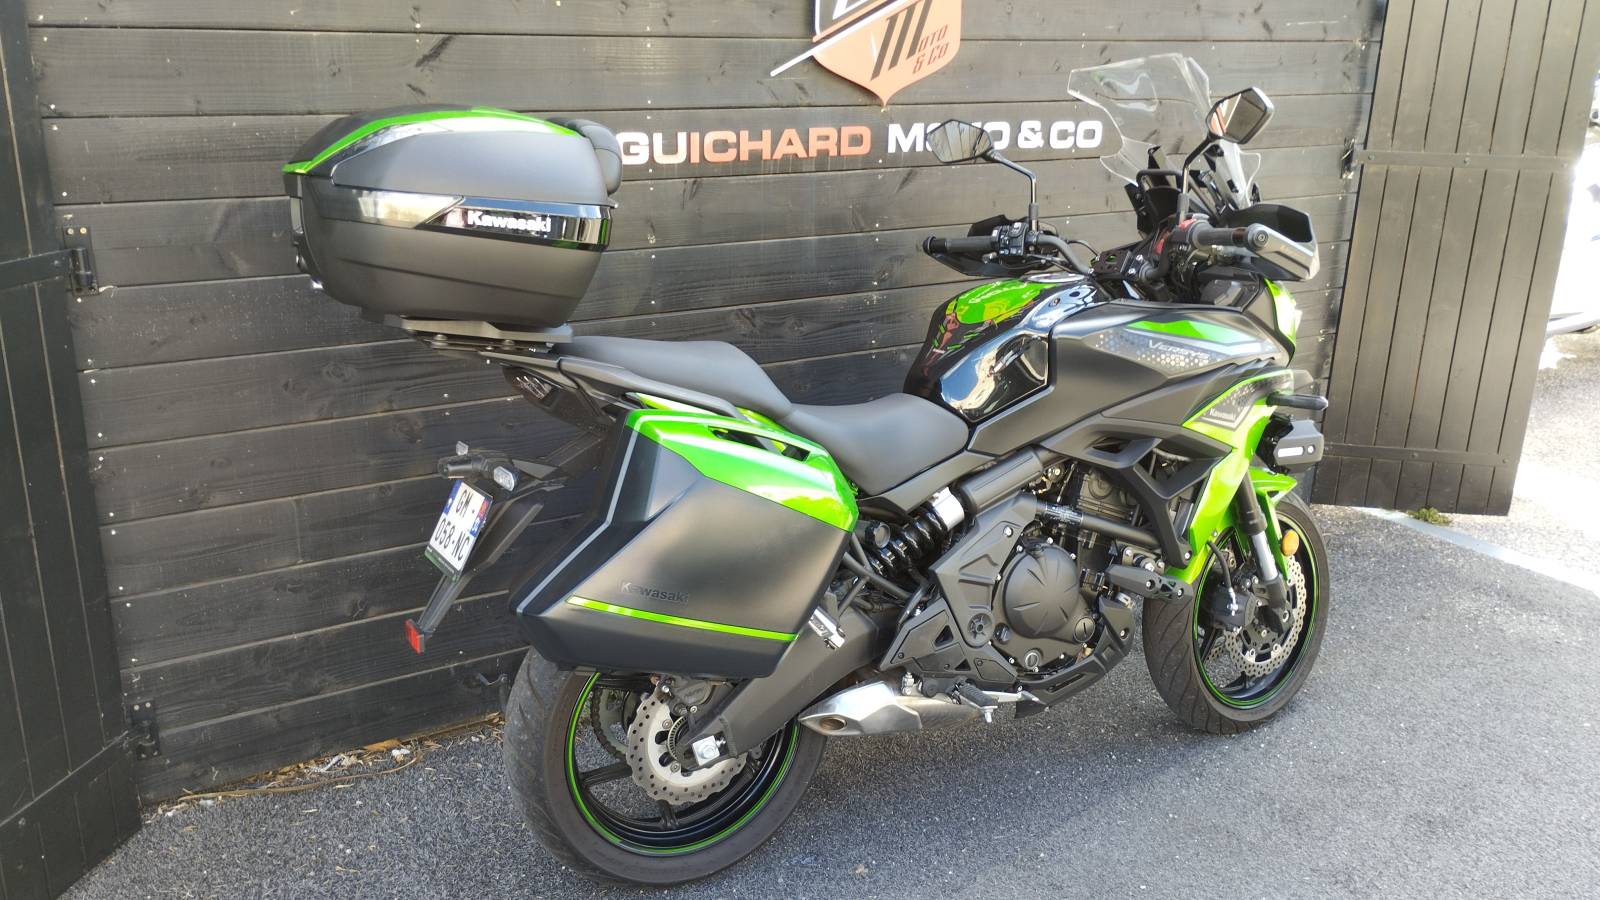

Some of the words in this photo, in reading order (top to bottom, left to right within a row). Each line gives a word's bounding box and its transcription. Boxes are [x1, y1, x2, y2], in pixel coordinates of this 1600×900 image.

[616, 126, 872, 165] GUICHARD
[887, 121, 1011, 154] MO
[1017, 120, 1045, 149] &
[1049, 120, 1103, 149] CO
[467, 209, 552, 233] Kawasaki
